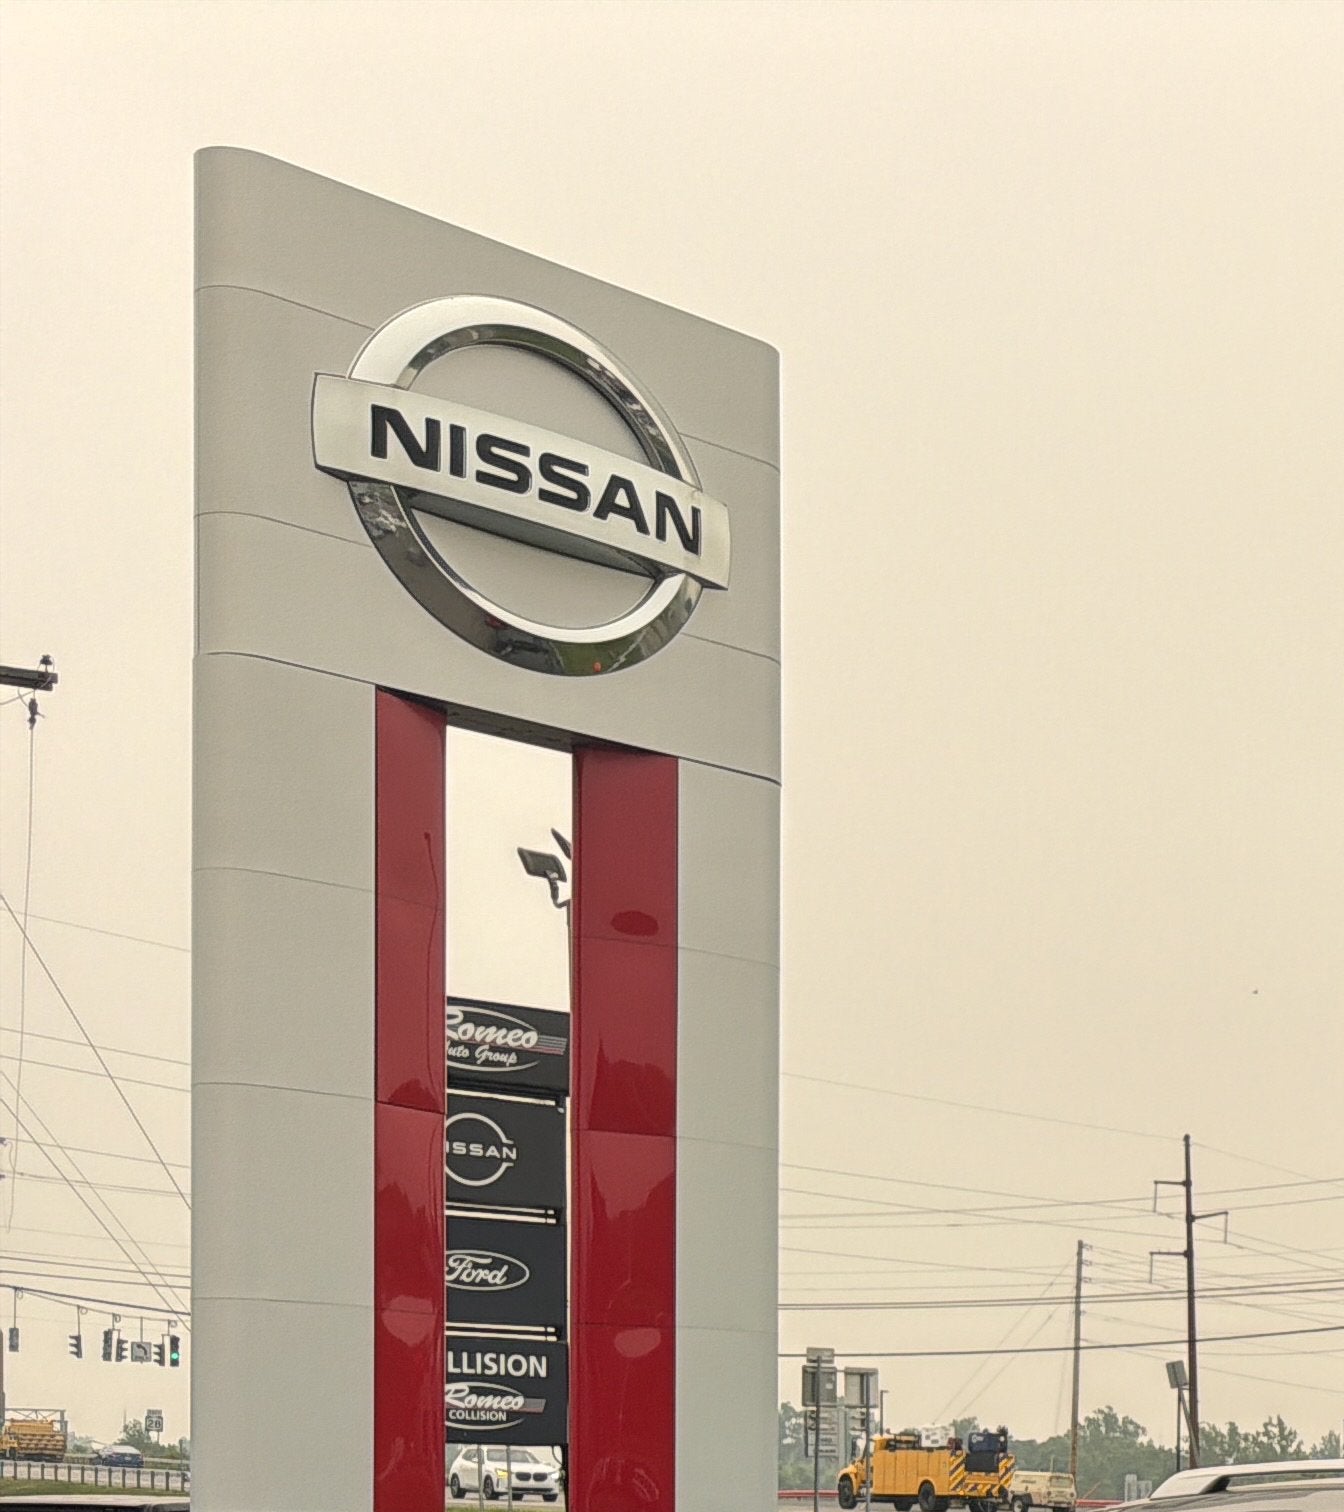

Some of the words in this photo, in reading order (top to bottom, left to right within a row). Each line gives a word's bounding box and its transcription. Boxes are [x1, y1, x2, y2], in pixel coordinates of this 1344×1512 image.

[370, 403, 702, 555] NISSAN
[475, 1044, 517, 1066] Group
[446, 1254, 509, 1285] Ford
[445, 1384, 525, 1410] Romeo
[147, 1420, 161, 1429] 28
[448, 1409, 507, 1421] COLLISION
